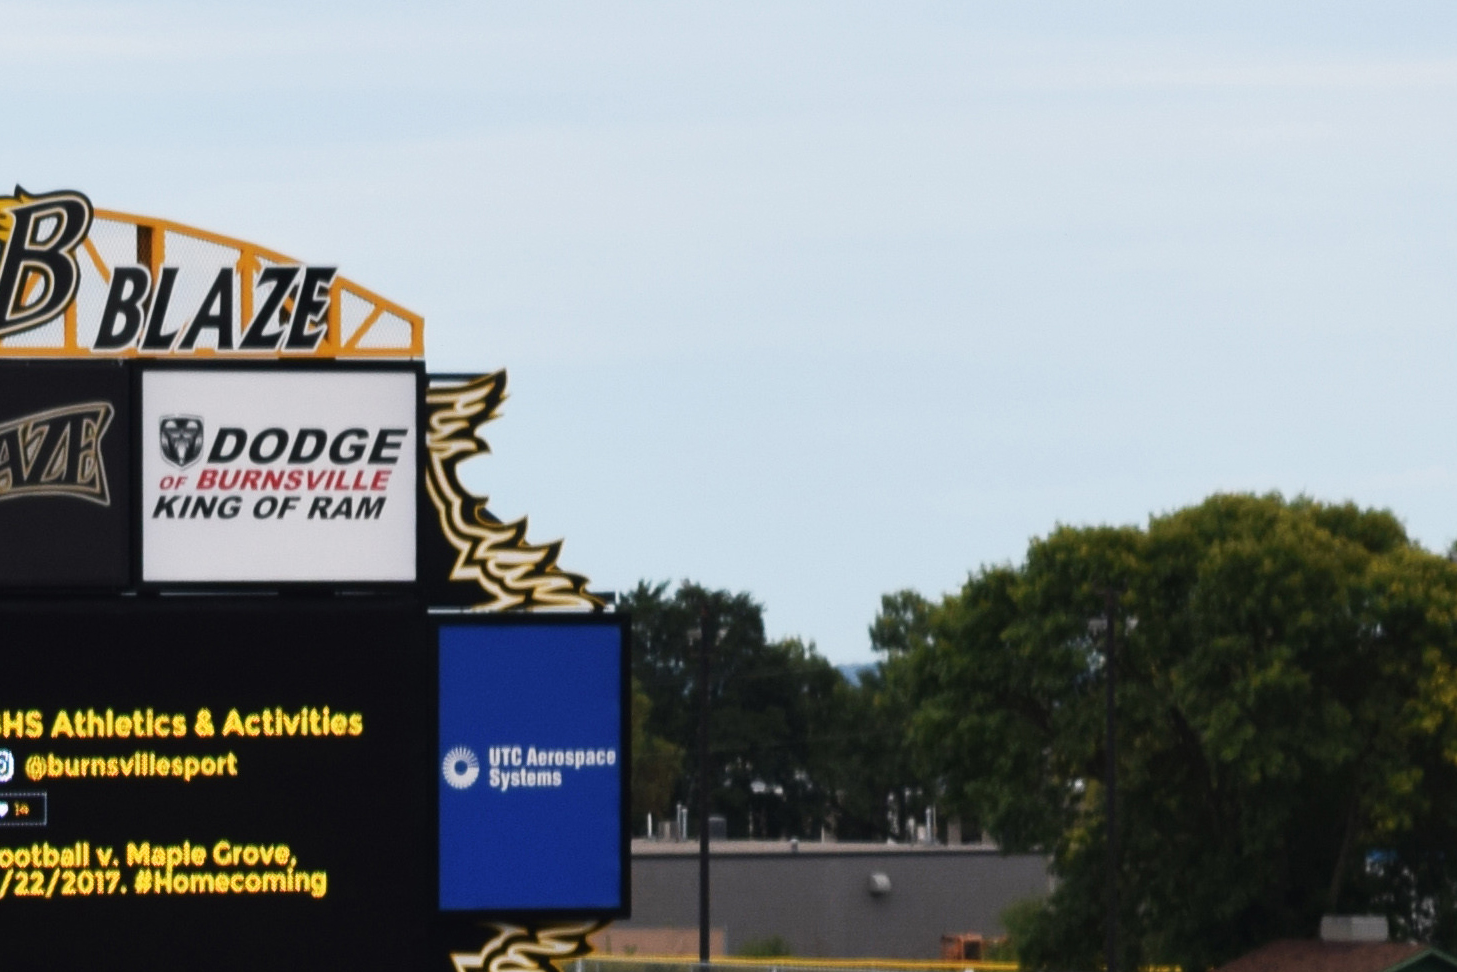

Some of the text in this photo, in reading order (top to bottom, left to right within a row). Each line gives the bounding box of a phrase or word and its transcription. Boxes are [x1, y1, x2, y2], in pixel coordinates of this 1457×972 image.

[91, 265, 338, 353] BLAZE
[207, 427, 408, 465] DODGE
[159, 469, 393, 491] OF BURNSVILLE
[152, 496, 387, 520] KING OF RAM
[51, 707, 187, 738] Athletics
[194, 707, 215, 738] &
[222, 705, 363, 737] Activities
[25, 751, 238, 782] @burnsvillesport
[489, 747, 616, 769] UTC Aerospace
[489, 769, 562, 792] Systems
[96, 848, 119, 868] v.
[126, 841, 207, 870] Maple
[213, 839, 297, 868] Grove,
[135, 866, 328, 899] #Homecoming
